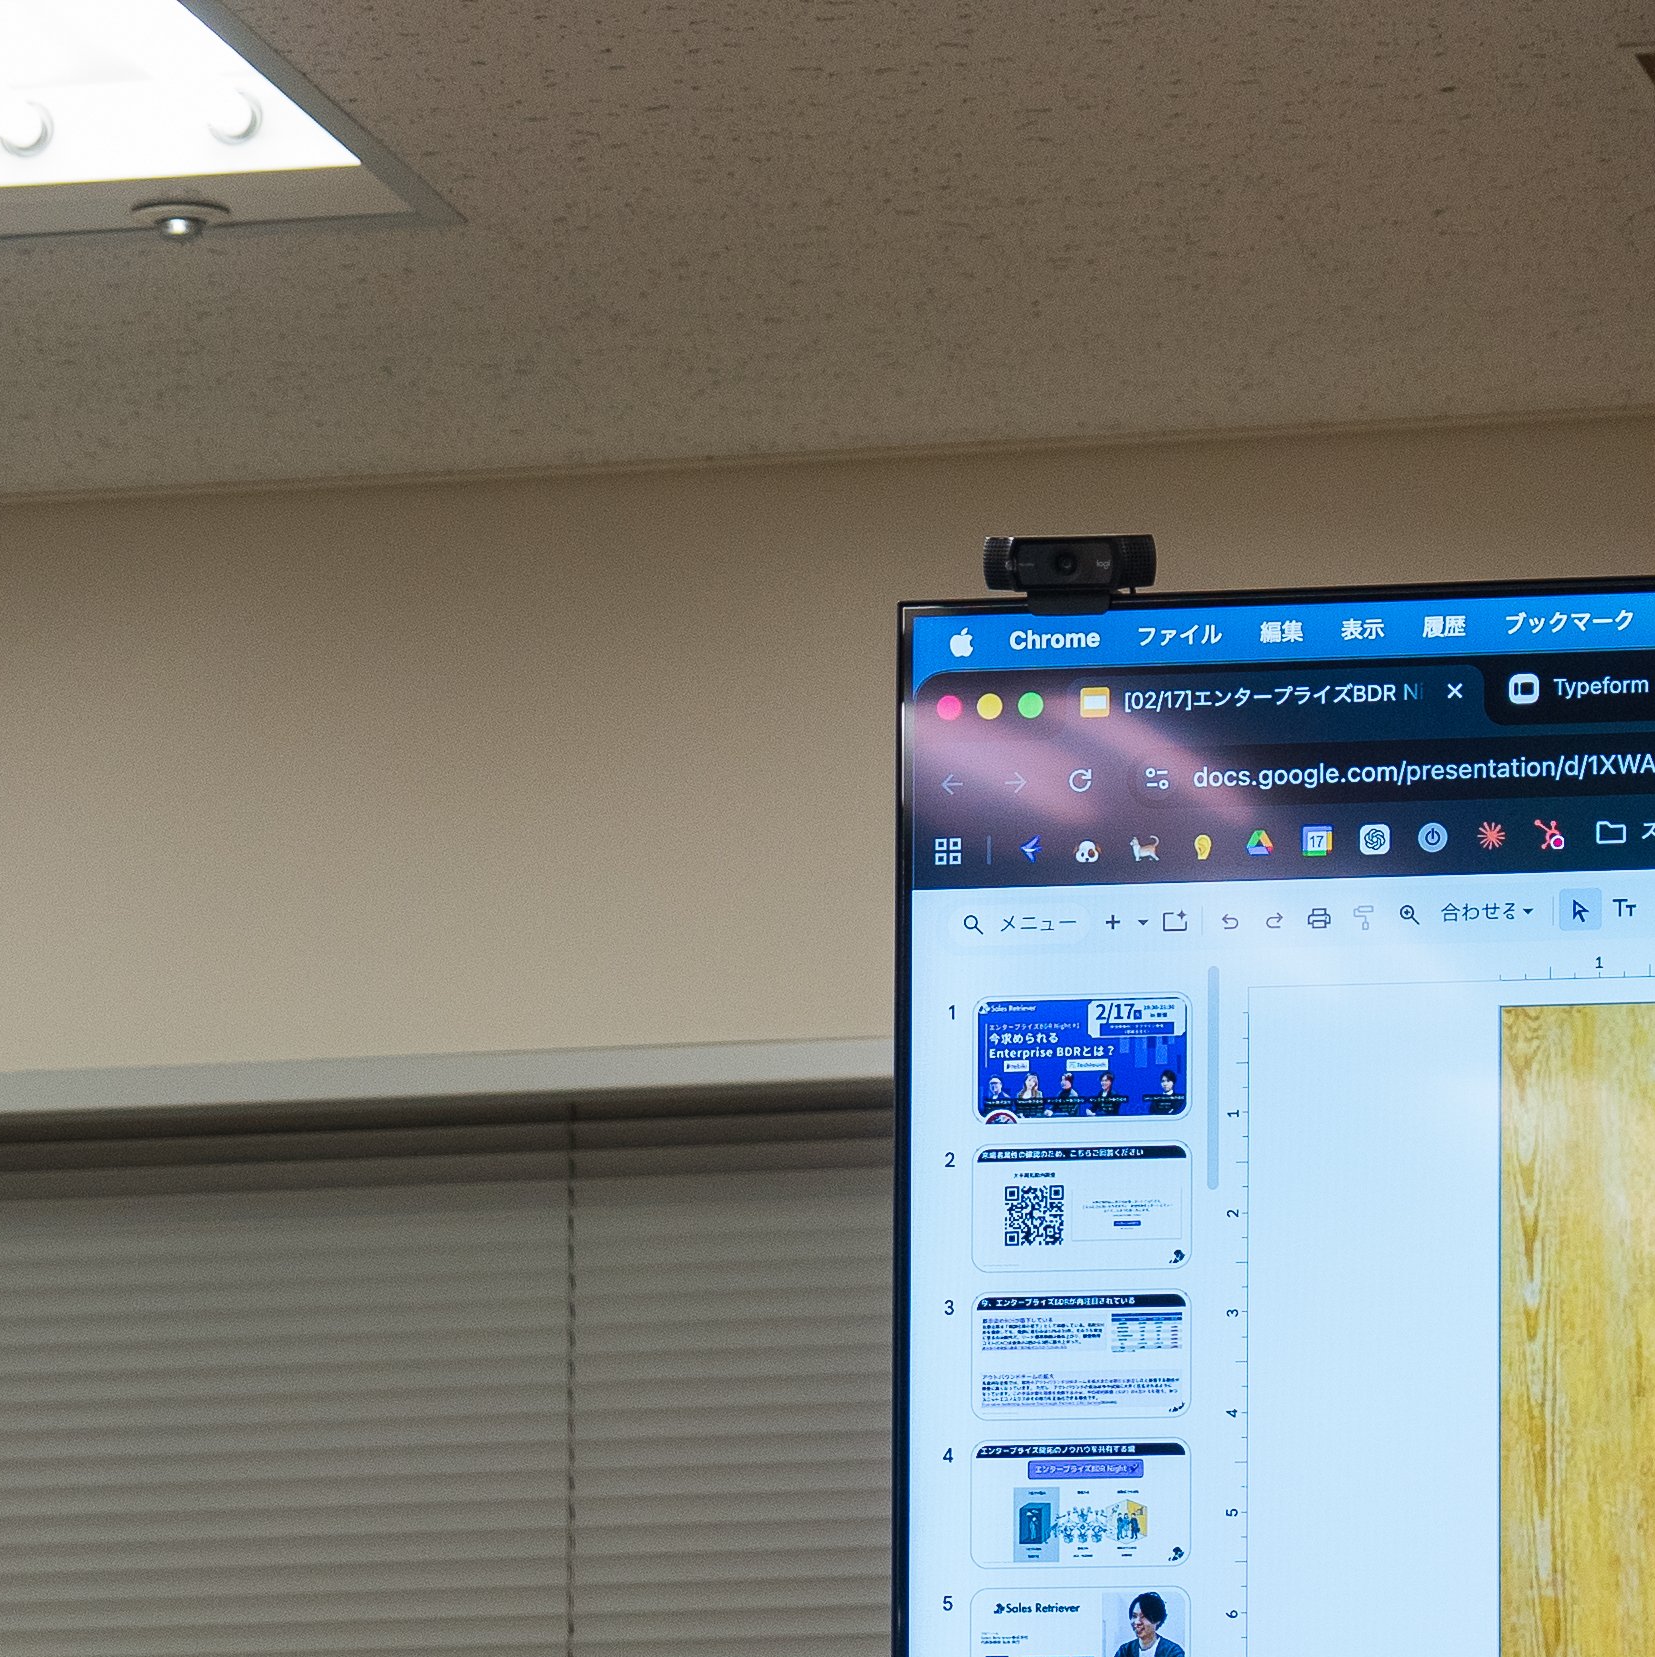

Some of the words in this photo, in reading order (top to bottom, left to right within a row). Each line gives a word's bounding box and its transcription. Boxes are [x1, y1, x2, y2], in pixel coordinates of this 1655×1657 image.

[1096, 559, 1112, 569] logi
[1341, 618, 1384, 640] 表示
[1423, 616, 1466, 638] 履歴
[1506, 610, 1633, 634] ブックマーク
[1139, 625, 1222, 646] ファイル
[1260, 620, 1303, 643] 編集
[1010, 630, 1100, 650] Chrome
[1553, 673, 1649, 700] Typeform
[1124, 684, 1396, 712] [02/17]エンタープライズBDR
[1441, 903, 1515, 922] 合わせる
[1001, 916, 1076, 931] メニュー
[1596, 957, 1603, 968] 1
[949, 1005, 954, 1020] 1
[1096, 1003, 1134, 1023] 2/17
[989, 1033, 1058, 1045] 今求められる
[989, 1047, 1053, 1059] Enterprise
[945, 1152, 955, 1167] 2
[945, 1300, 954, 1315] 3
[1227, 1309, 1238, 1317] 3
[1226, 1409, 1237, 1418] 4
[943, 1448, 953, 1463] 4
[943, 1596, 953, 1611] 5
[1006, 1602, 1032, 1613] Sales
[1035, 1603, 1080, 1613] Retriever
[1226, 1610, 1238, 1618] 6
